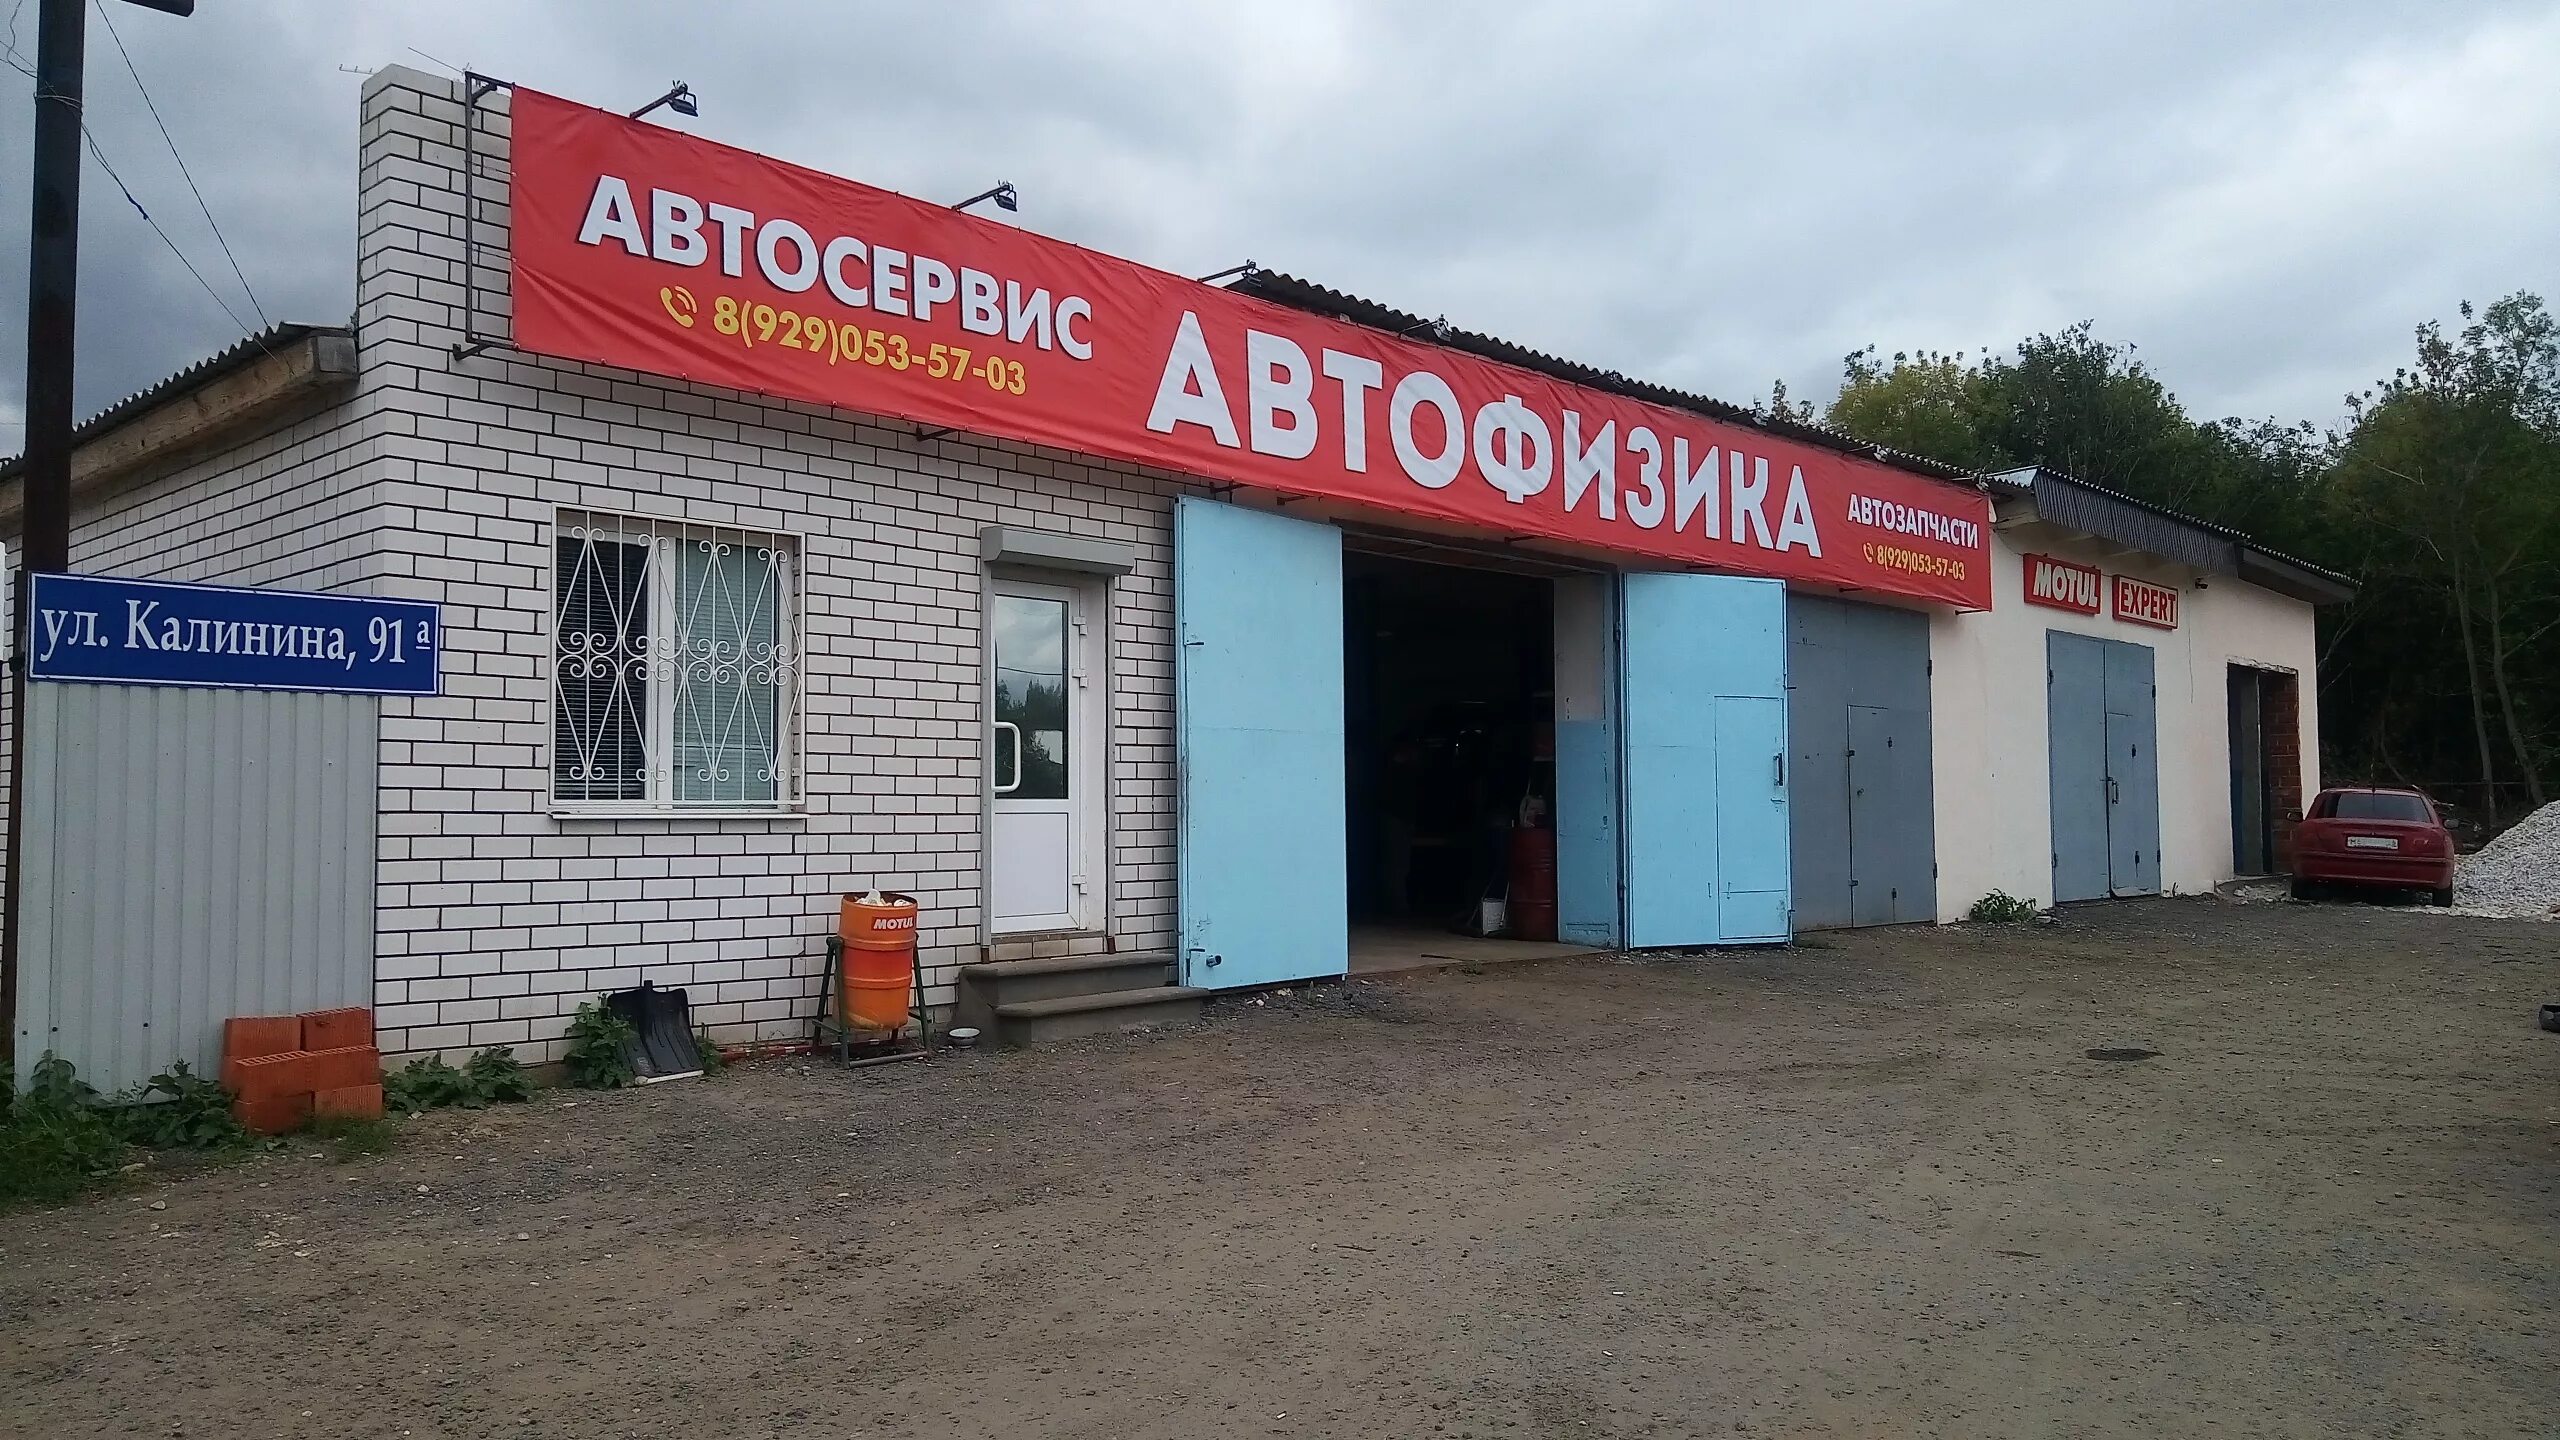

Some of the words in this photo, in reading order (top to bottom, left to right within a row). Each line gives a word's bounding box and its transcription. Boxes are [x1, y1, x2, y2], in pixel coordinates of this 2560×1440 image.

[578, 173, 1093, 361] АВТОСЕРВИС
[713, 295, 1027, 396] 8(929)053-57-03
[1145, 309, 1822, 560] АВТОФИЗИКА
[1846, 493, 1979, 549] АВТОЗАПЧАСТИ
[1876, 544, 1965, 581] 8(929)053-57-03
[2032, 562, 2099, 608] MOTUL
[2121, 582, 2177, 623] EXPERT
[40, 608, 108, 662] ул.
[124, 599, 357, 670] Калинина,
[368, 616, 406, 664] 91
[874, 917, 914, 929] MOTUL
